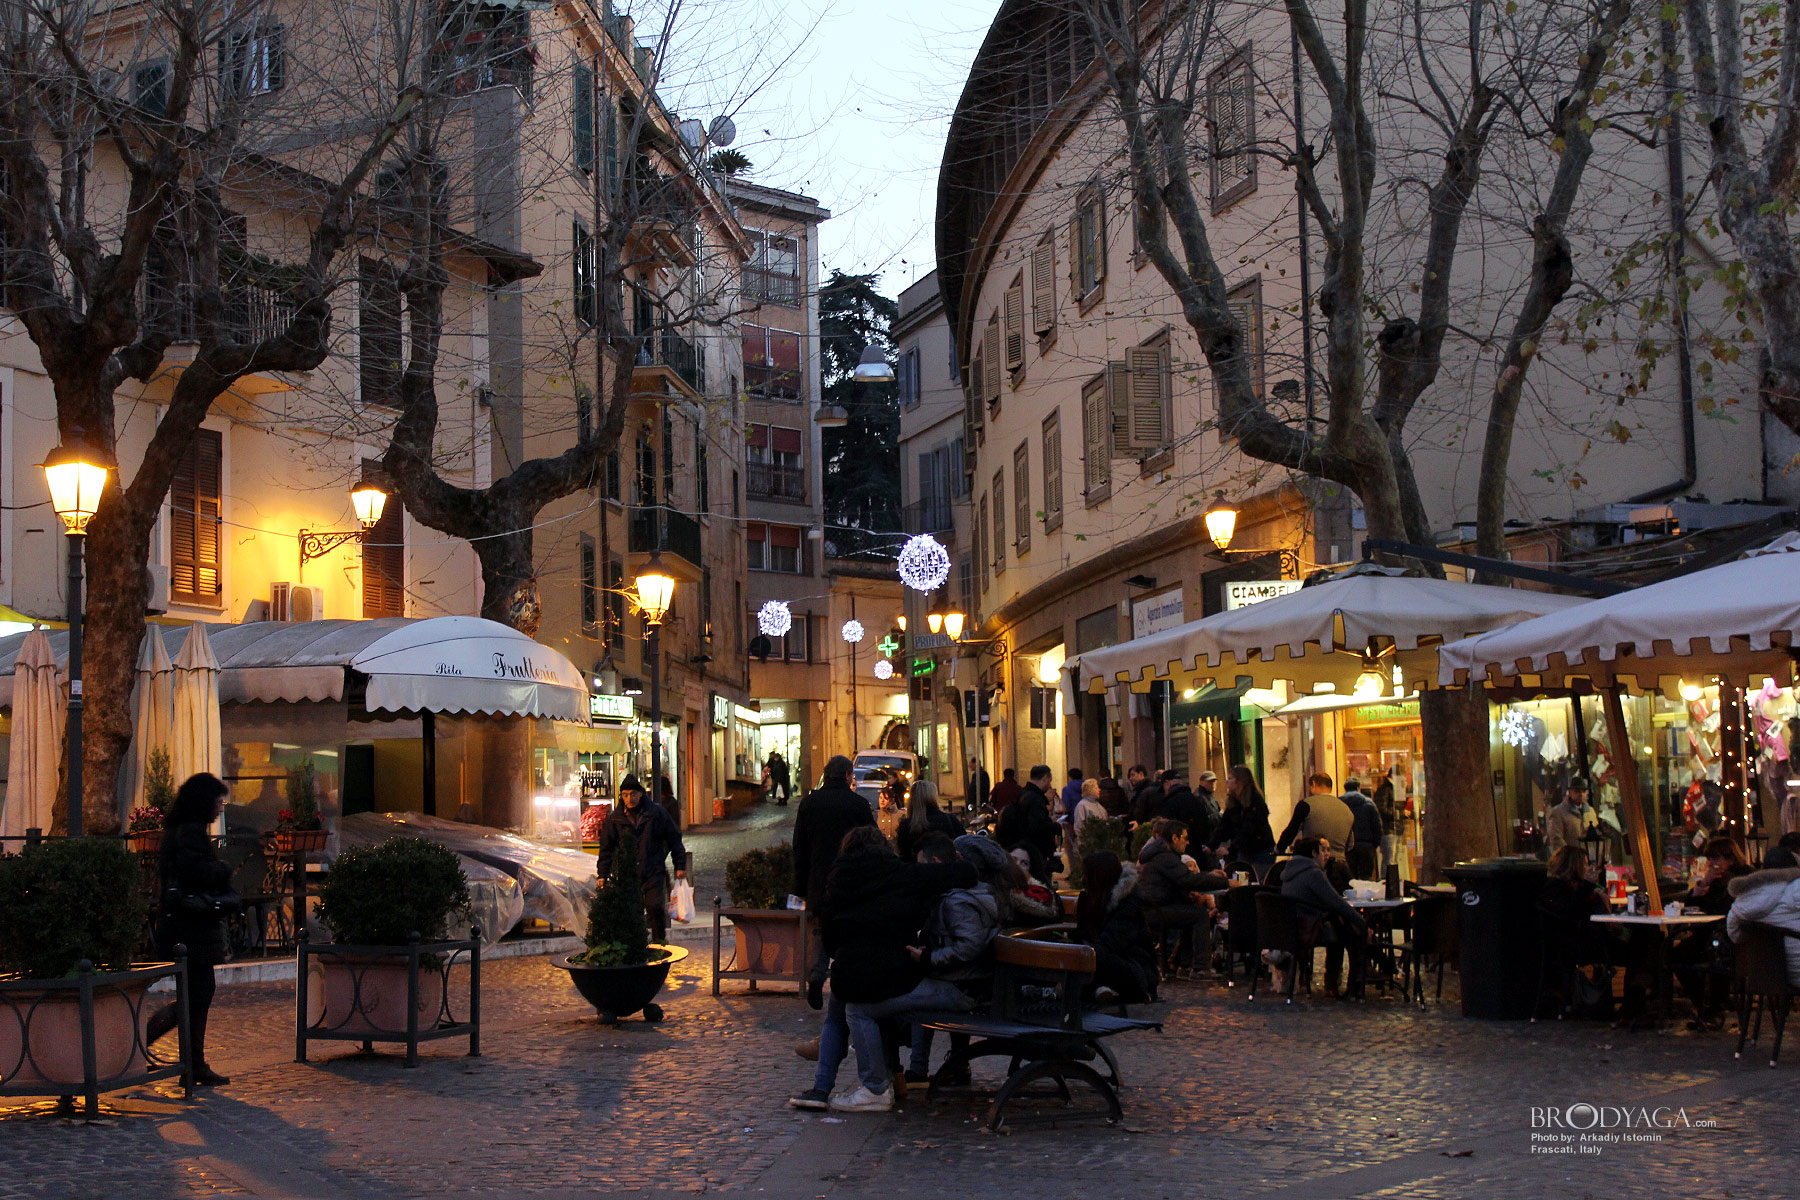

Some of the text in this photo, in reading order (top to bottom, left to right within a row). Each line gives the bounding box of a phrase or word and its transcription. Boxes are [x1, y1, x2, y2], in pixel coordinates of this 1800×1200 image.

[915, 631, 970, 649] PROFUMA
[435, 652, 560, 683] Rita Frutteria
